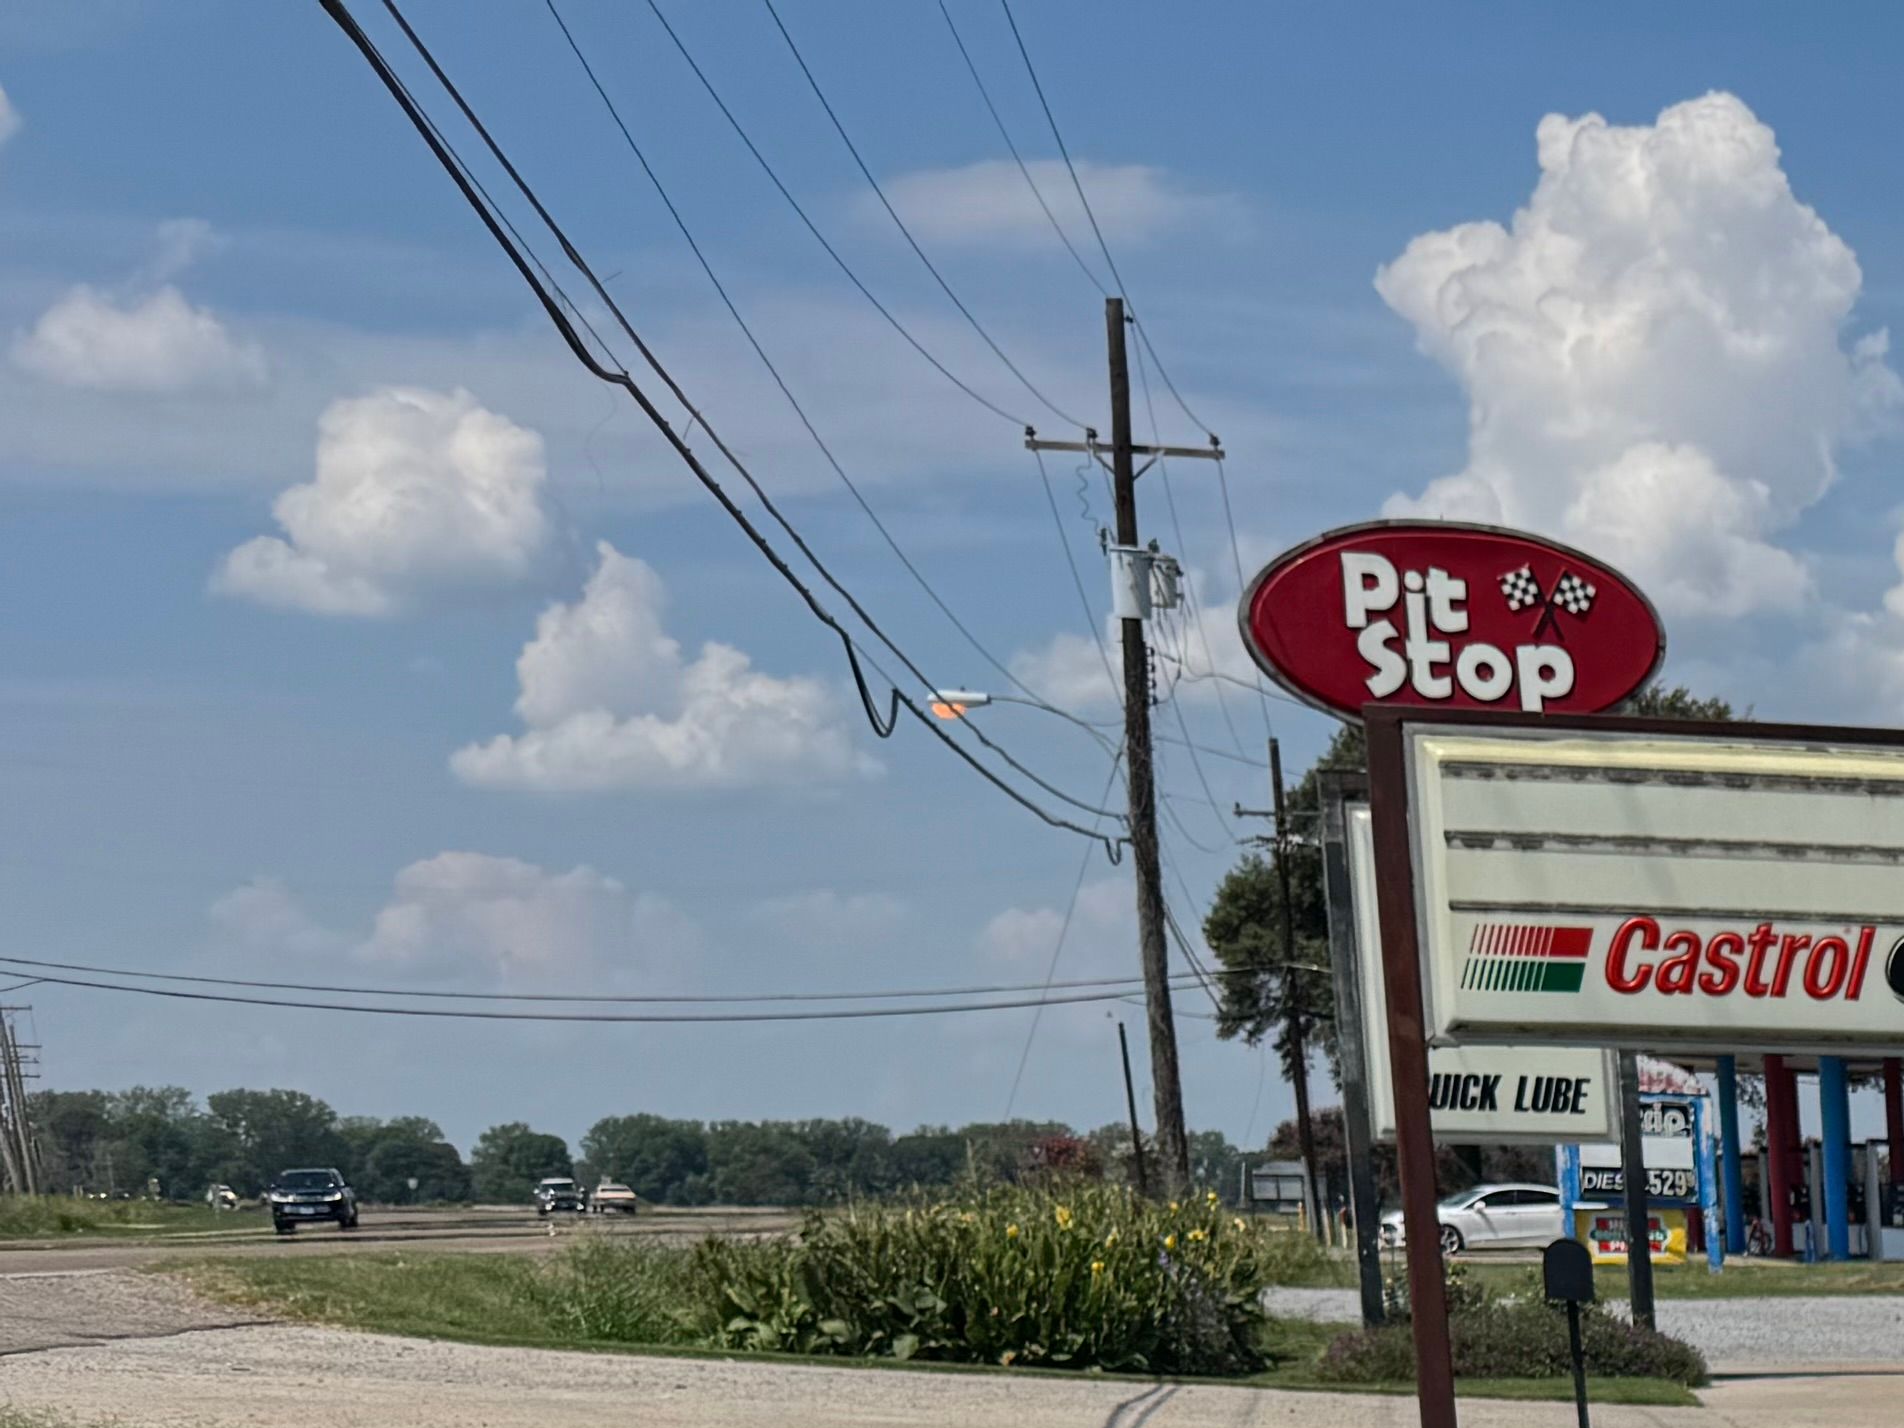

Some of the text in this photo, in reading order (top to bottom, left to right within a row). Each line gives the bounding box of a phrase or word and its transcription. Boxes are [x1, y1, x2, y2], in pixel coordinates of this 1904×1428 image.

[1340, 552, 1469, 642] Pit
[1357, 619, 1575, 712] Stop
[1604, 914, 1876, 1001] Castrol
[1430, 1074, 1501, 1111] UICK
[1514, 1075, 1592, 1115] LUBE
